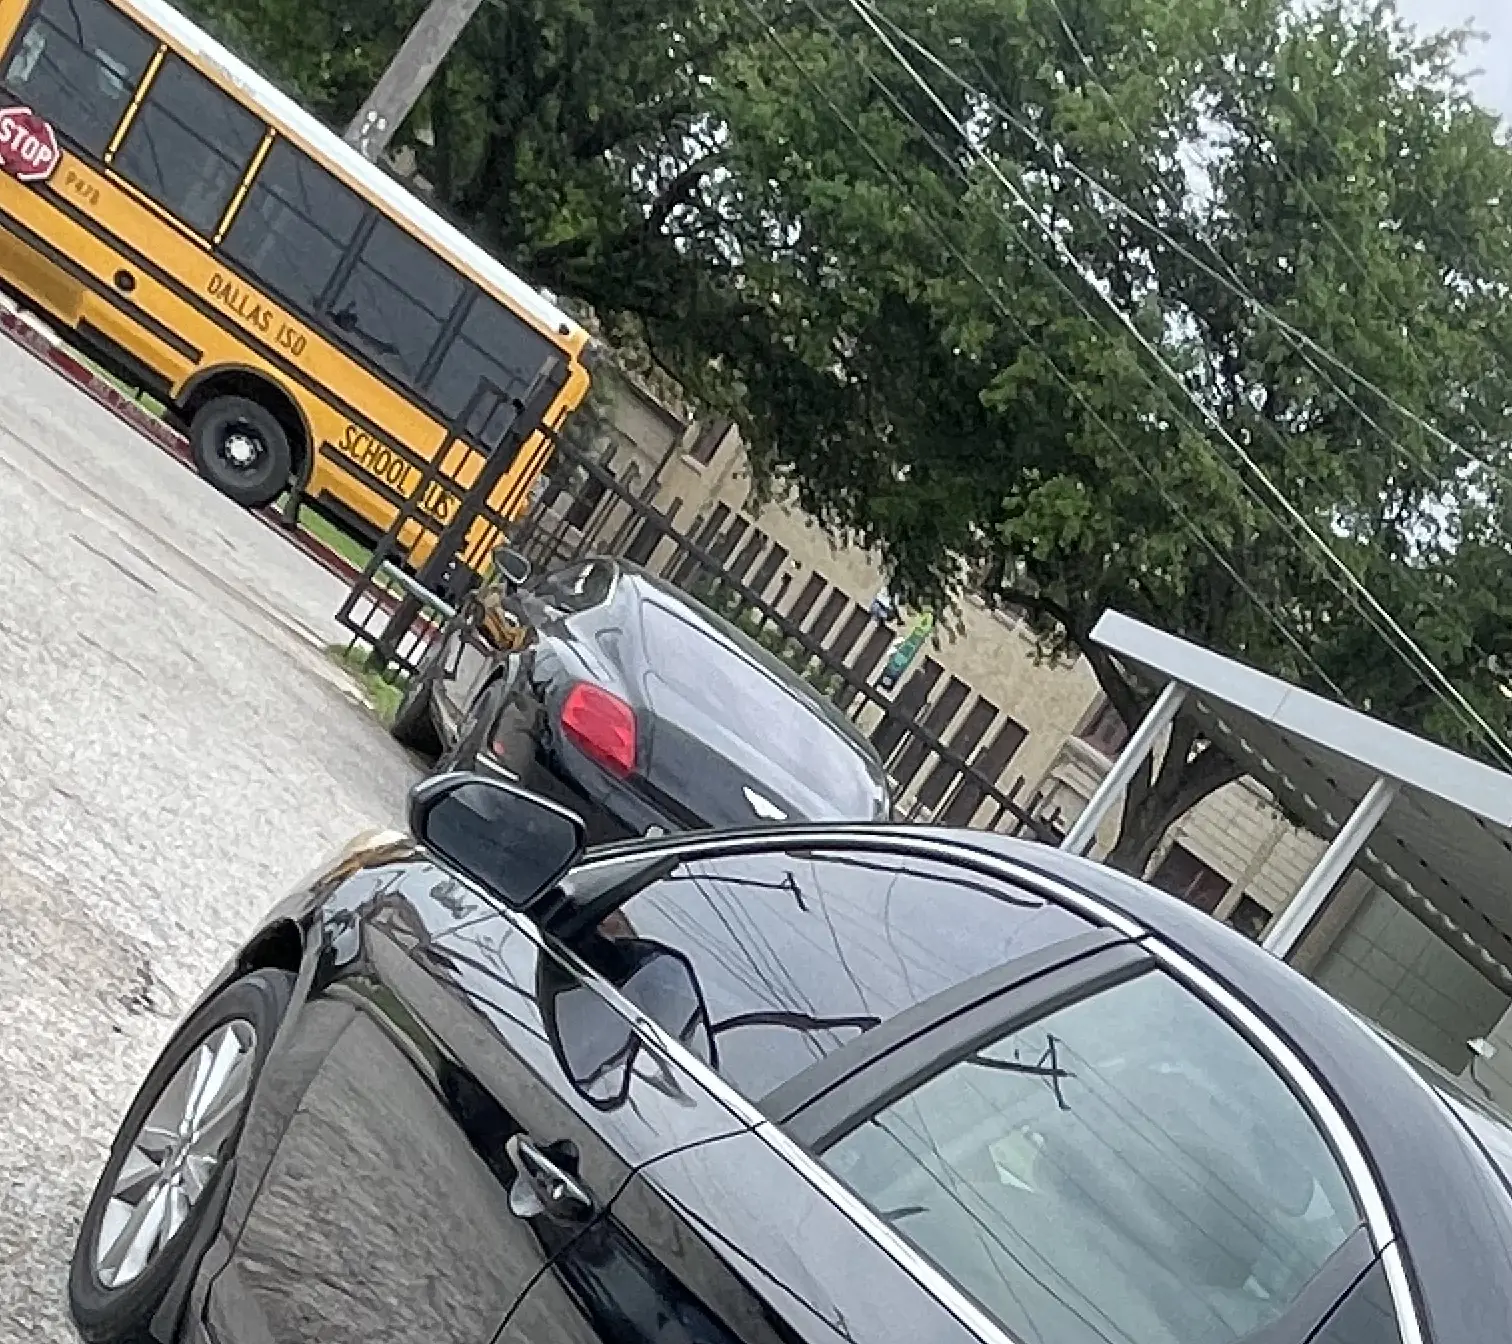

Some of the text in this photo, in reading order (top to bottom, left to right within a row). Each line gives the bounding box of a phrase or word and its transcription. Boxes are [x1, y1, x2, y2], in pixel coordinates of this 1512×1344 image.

[0, 117, 52, 168] STOP
[207, 272, 308, 357] DALLAS ISD
[339, 424, 457, 519] SCHOOL US
